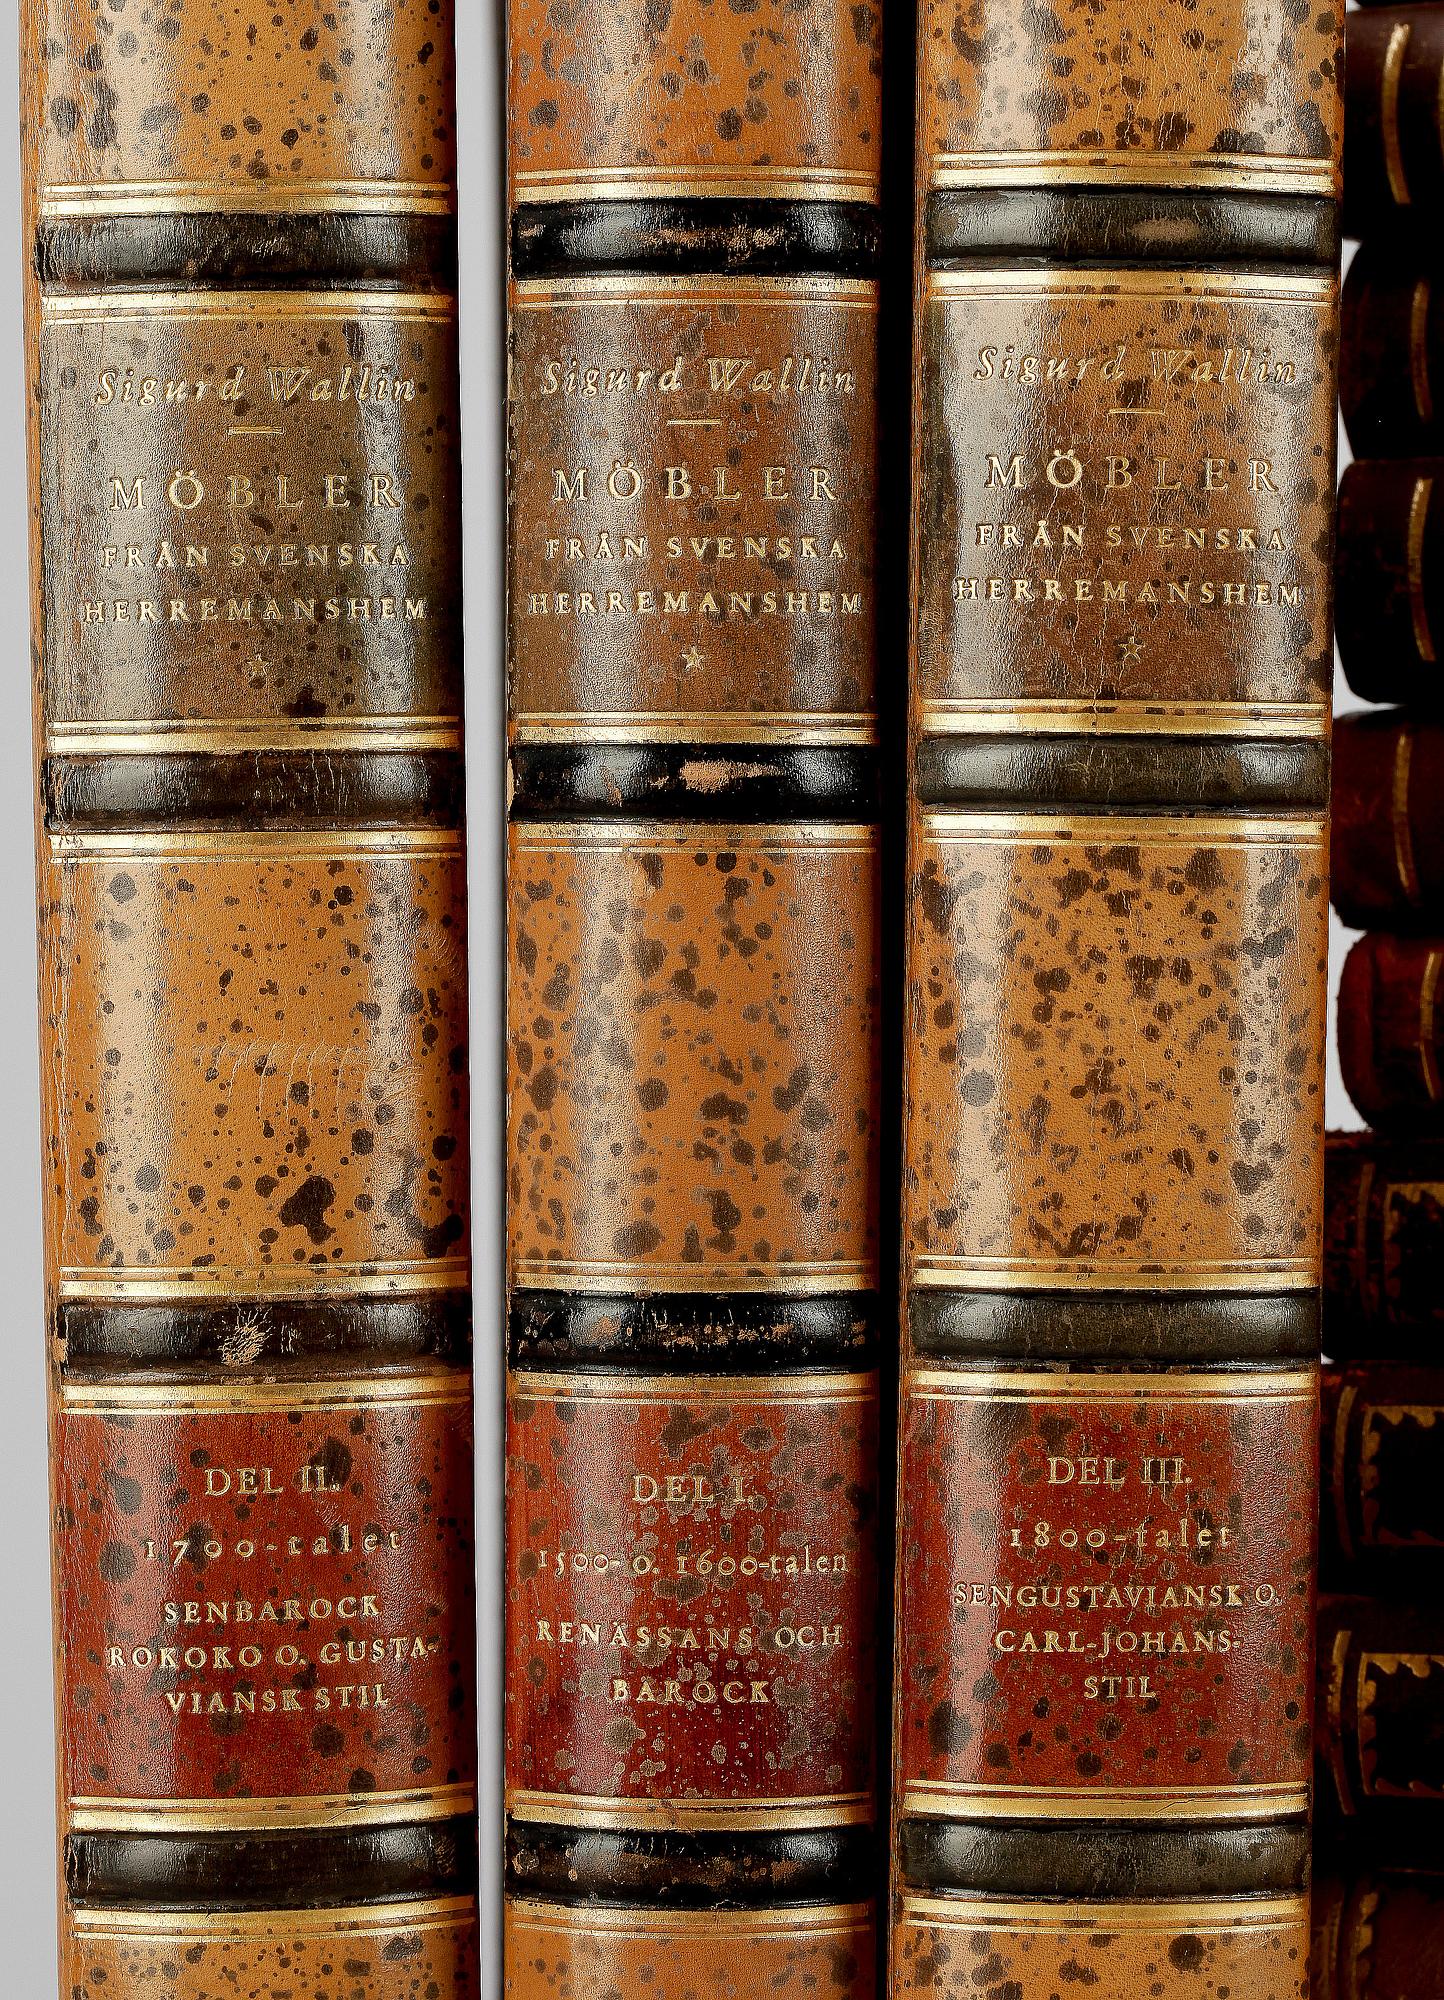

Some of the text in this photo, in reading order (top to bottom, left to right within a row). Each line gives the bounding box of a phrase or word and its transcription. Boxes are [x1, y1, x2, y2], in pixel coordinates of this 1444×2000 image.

[541, 353, 855, 397] Sigurd Wallin
[974, 345, 1296, 385] Sigurd Wallin
[95, 366, 416, 406] Sigurd Wallin
[553, 460, 838, 502] MÖBLER
[984, 449, 1279, 493] MÖBLER
[109, 470, 401, 512] MÖBLER
[545, 531, 847, 560] FRÅN SVENSKA
[975, 520, 1287, 551] FRÅN SVENSKA
[101, 541, 412, 569] FRÅN SVENSKA
[527, 591, 864, 615] HERREMANSHEM
[954, 576, 1302, 607] HERREMANSHEM
[83, 598, 428, 624] HERREMANSHEM
[204, 1467, 285, 1497] DEL
[1046, 1455, 1193, 1486] DEL III.
[632, 1473, 714, 1503] DEL
[142, 1525, 402, 1566] 1700-talet
[1010, 1520, 1231, 1548] 1800-talet
[676, 1545, 849, 1576] 1600-talen
[164, 1594, 381, 1624] SENBAROCK
[952, 1582, 1244, 1608] SENGUSTAVIANSK
[536, 1618, 844, 1649] RENÄSSANS OCH
[107, 1644, 262, 1669] ROKOKO
[319, 1635, 438, 1664] GUSTA-
[166, 1682, 390, 1714] VIANSK STIL
[610, 1678, 773, 1704] BAROCK
[1083, 1676, 1156, 1700] STIL
